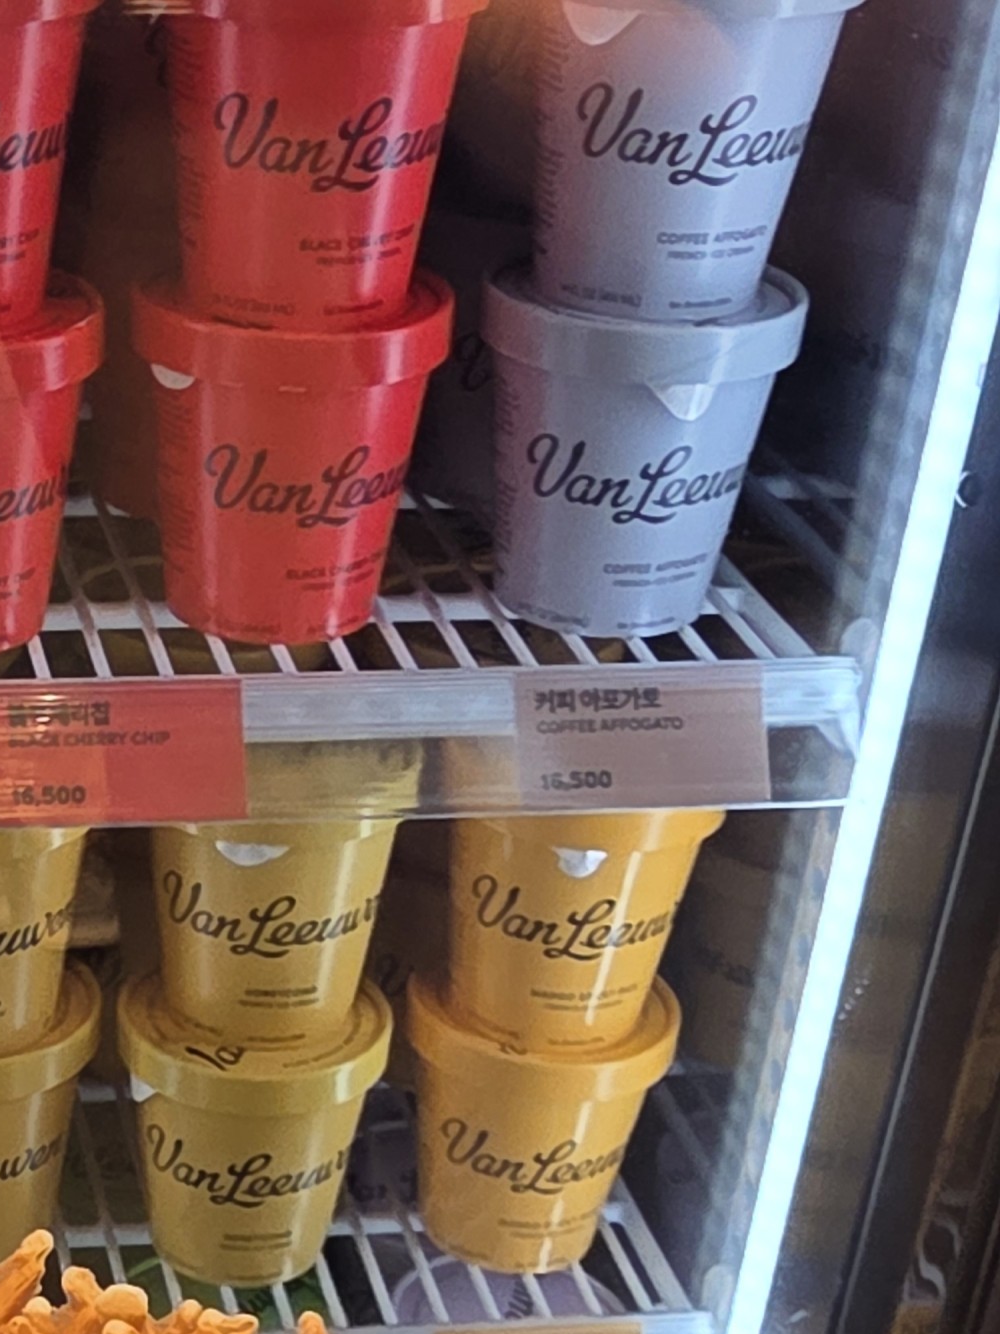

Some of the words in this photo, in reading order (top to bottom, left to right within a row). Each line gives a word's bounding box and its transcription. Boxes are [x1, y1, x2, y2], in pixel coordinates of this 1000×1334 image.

[214, 91, 335, 174] Van
[577, 81, 692, 167] Van
[204, 443, 317, 514] Van
[527, 433, 632, 508] Van
[536, 719, 597, 734] COFFEE
[601, 716, 684, 731] AFFOGATO
[163, 869, 245, 943] Van
[472, 873, 564, 947] Van
[147, 1123, 226, 1196] Van
[441, 1117, 527, 1188] Van
